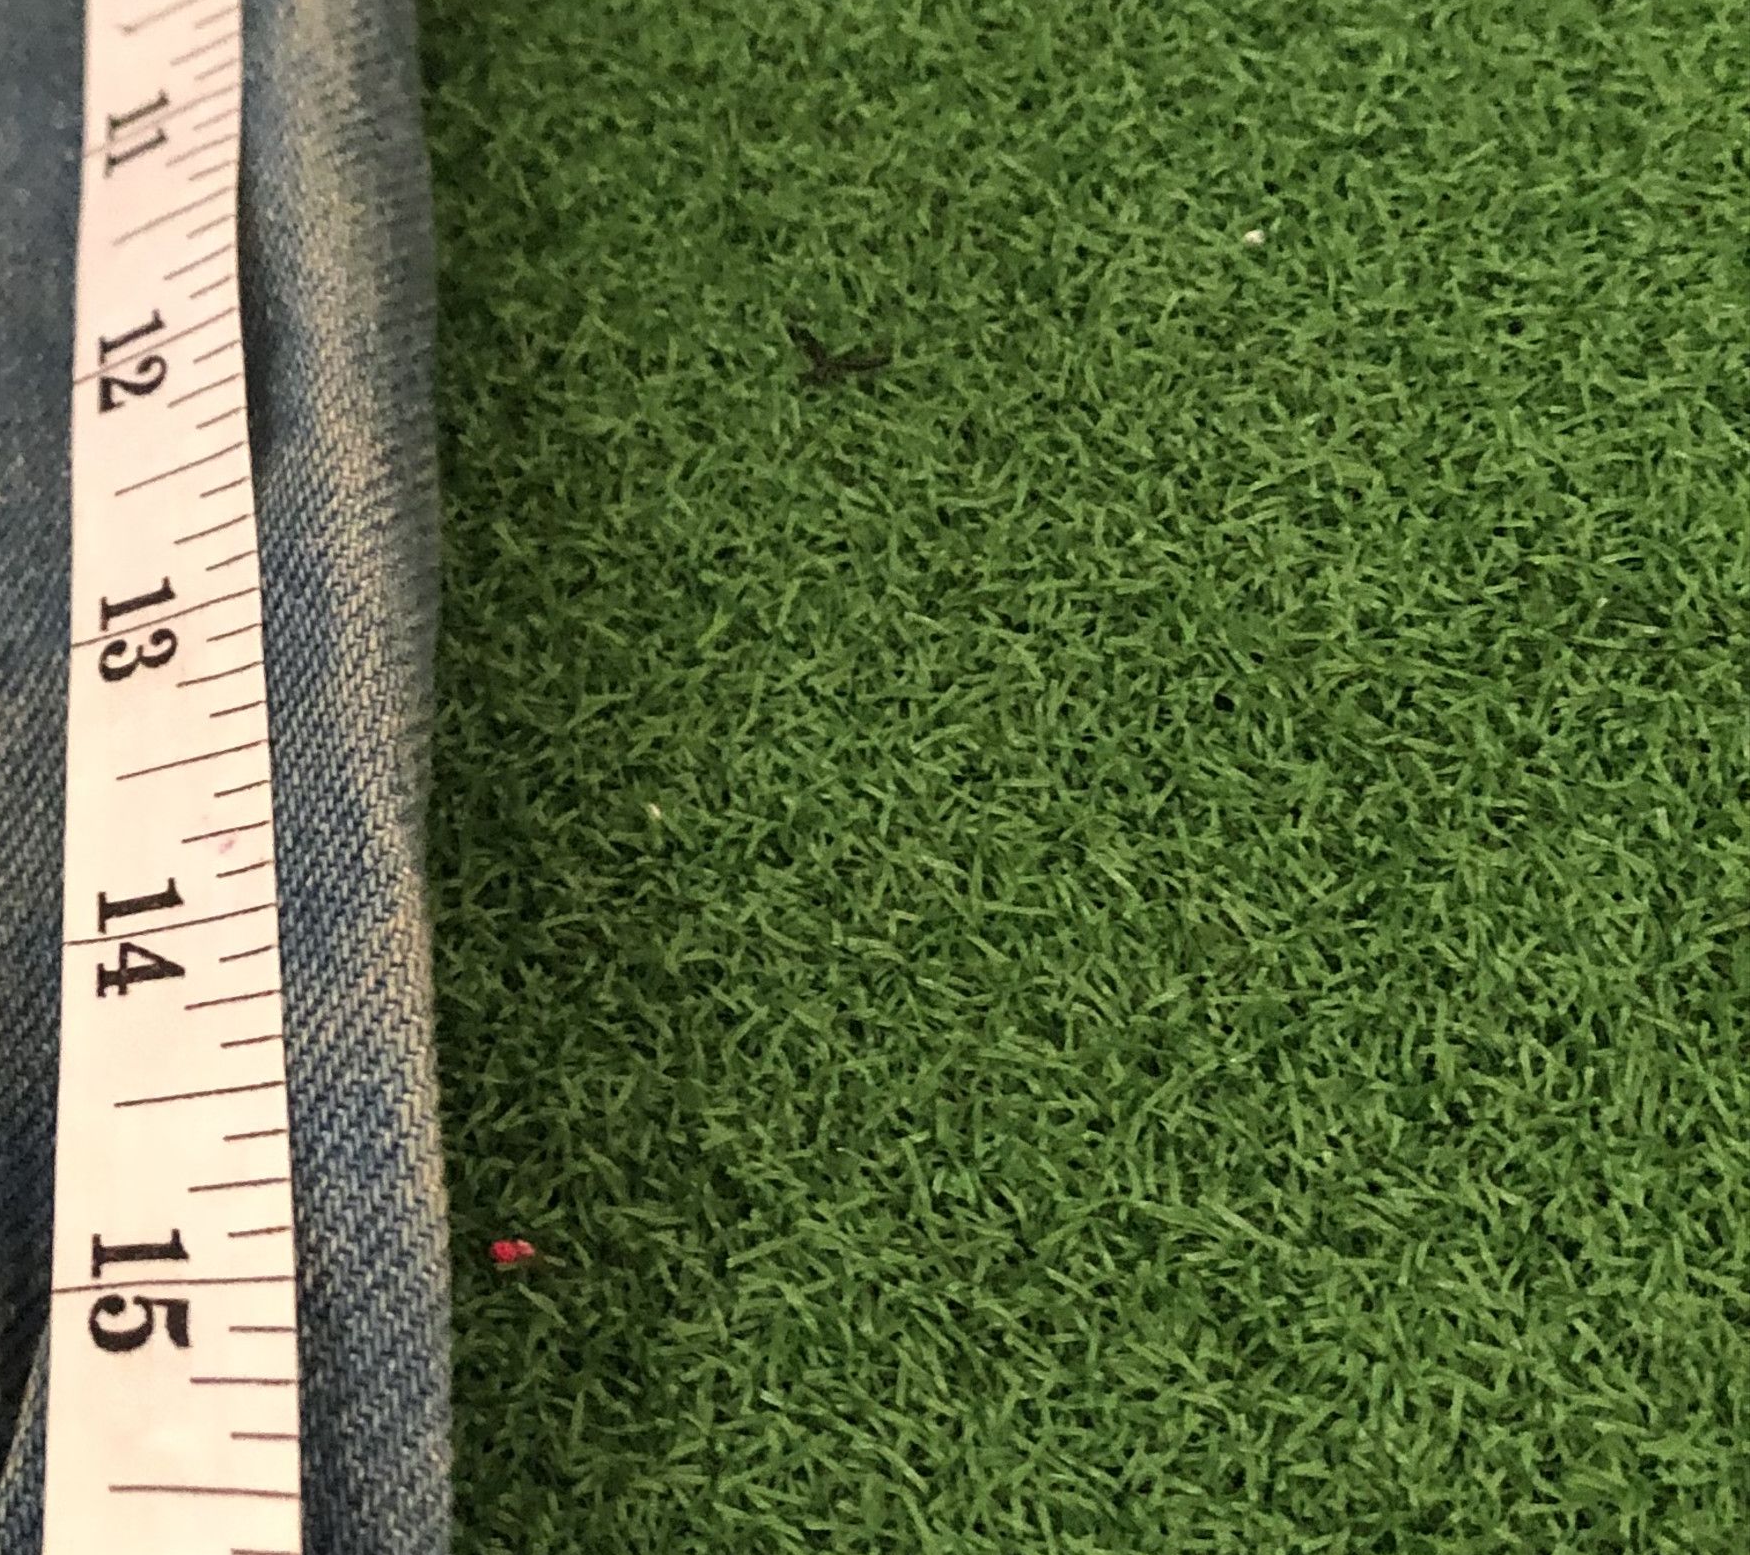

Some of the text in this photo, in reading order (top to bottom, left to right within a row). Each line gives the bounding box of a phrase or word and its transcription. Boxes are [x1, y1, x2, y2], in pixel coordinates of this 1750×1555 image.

[103, 89, 170, 179] 11
[97, 308, 169, 415] 12
[97, 576, 179, 685] 13
[94, 877, 188, 1000] 14
[87, 1227, 193, 1354] 15
